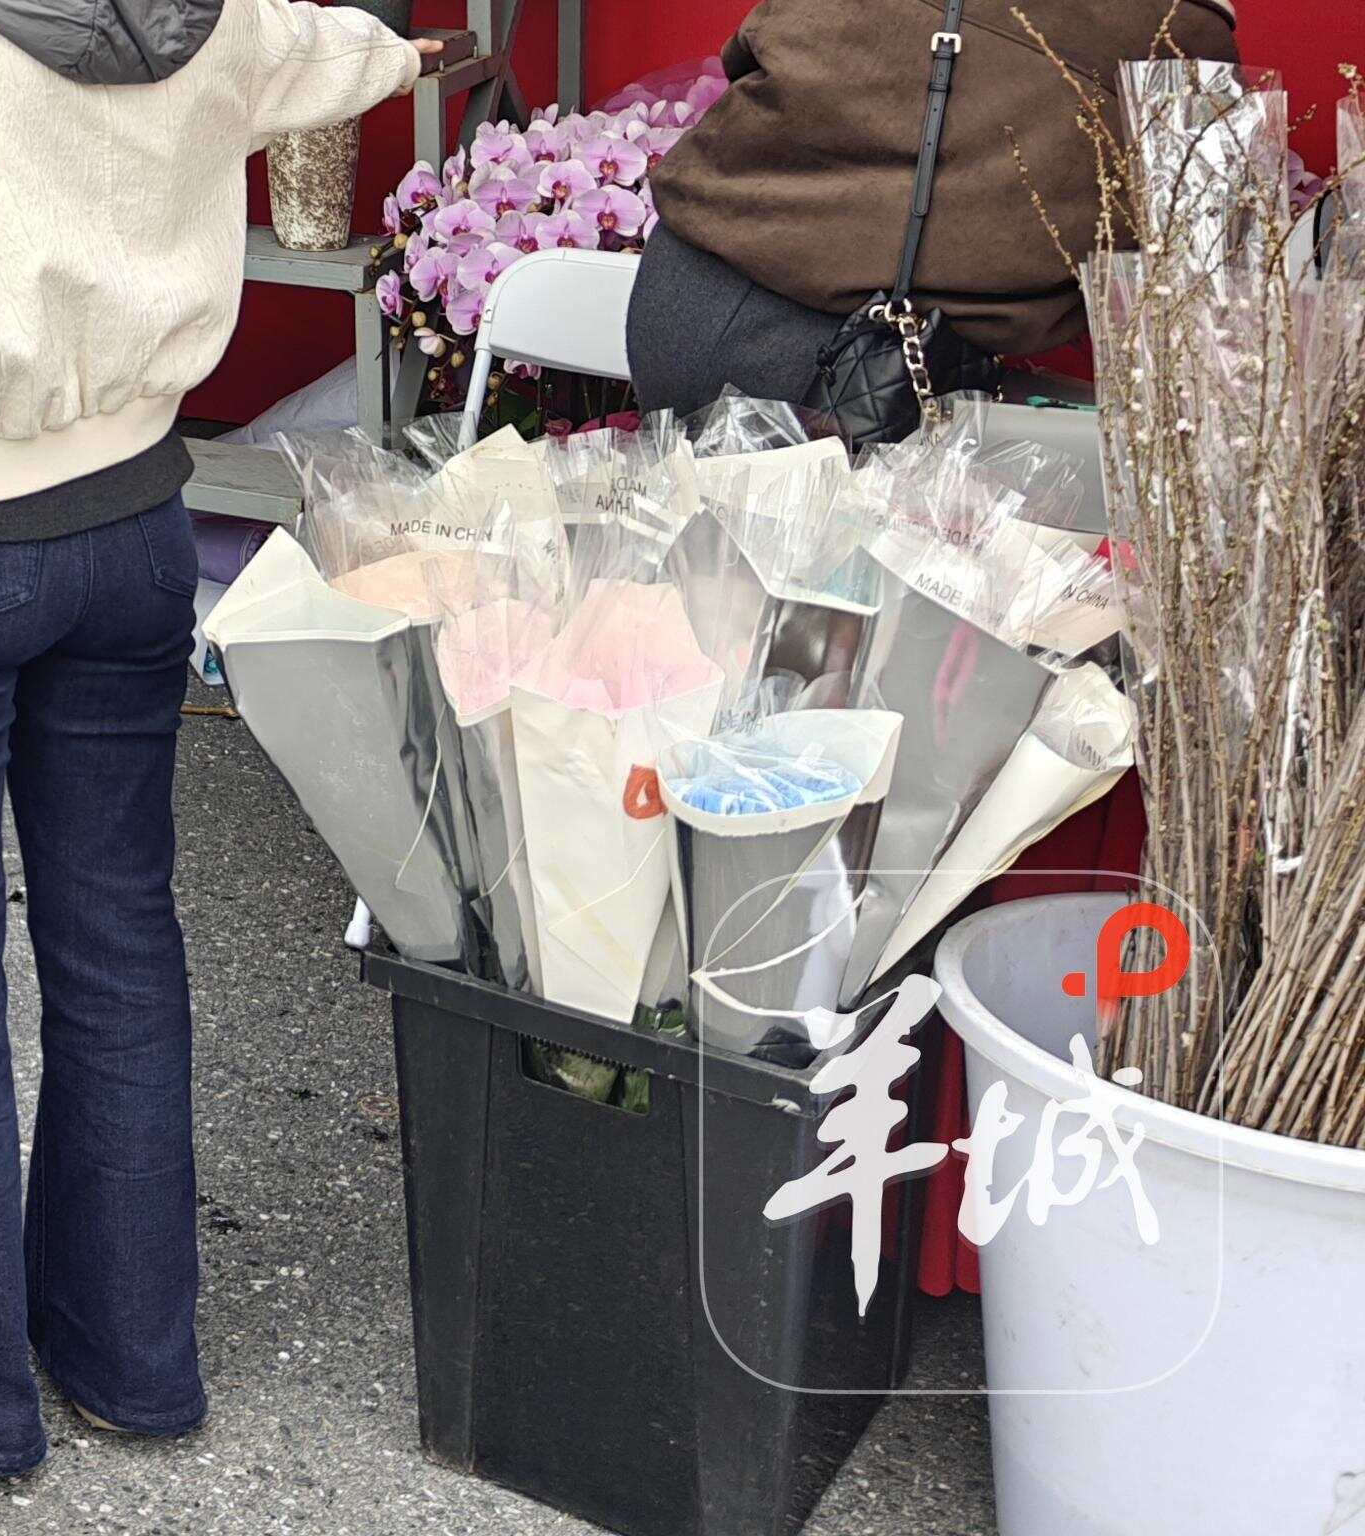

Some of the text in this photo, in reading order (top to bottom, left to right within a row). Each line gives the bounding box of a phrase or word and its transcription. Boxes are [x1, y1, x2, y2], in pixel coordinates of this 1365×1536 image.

[390, 519, 493, 542] MADE IN CHIN
[914, 572, 963, 607] MADE
